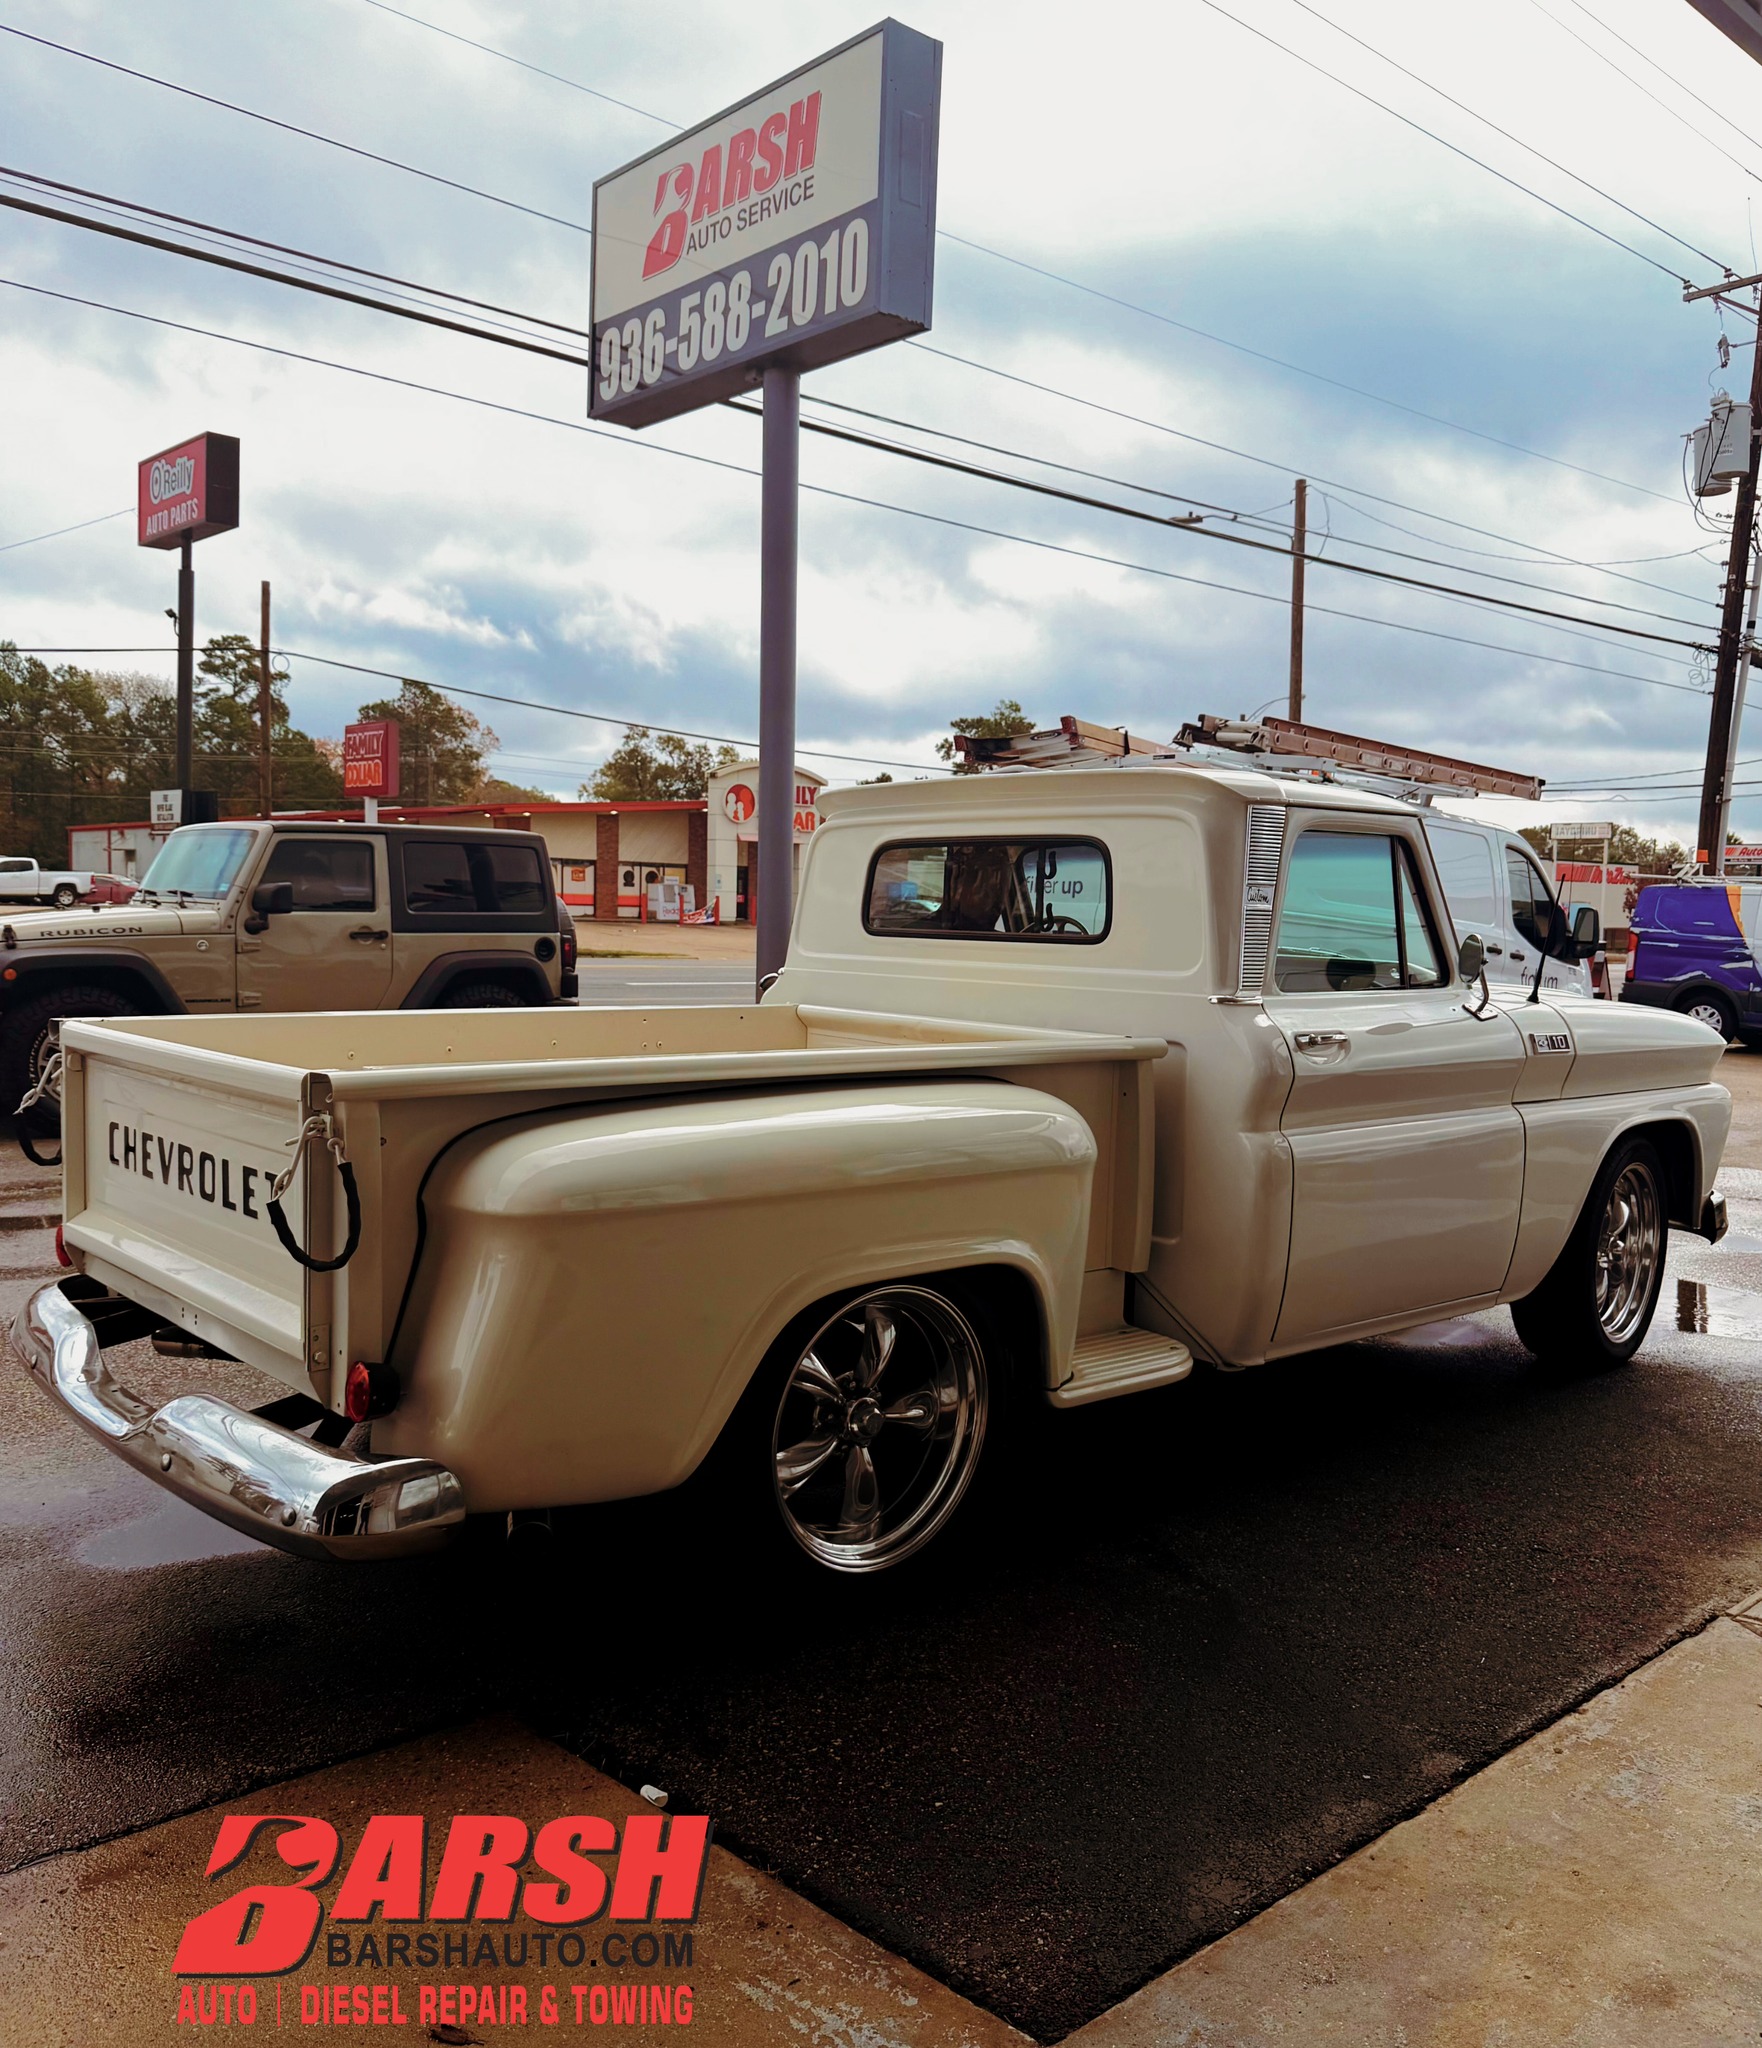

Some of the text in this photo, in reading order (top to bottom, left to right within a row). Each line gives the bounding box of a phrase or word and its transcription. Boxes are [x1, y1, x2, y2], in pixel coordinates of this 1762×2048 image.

[642, 90, 822, 282] BARSH
[686, 175, 815, 255] AUTO SERVICE
[599, 217, 869, 401] 936-588-2010
[146, 498, 199, 536] AUTO PARTS
[1061, 880, 1083, 899] up
[40, 926, 143, 937] RUBICON
[1552, 1036, 1566, 1049] 10
